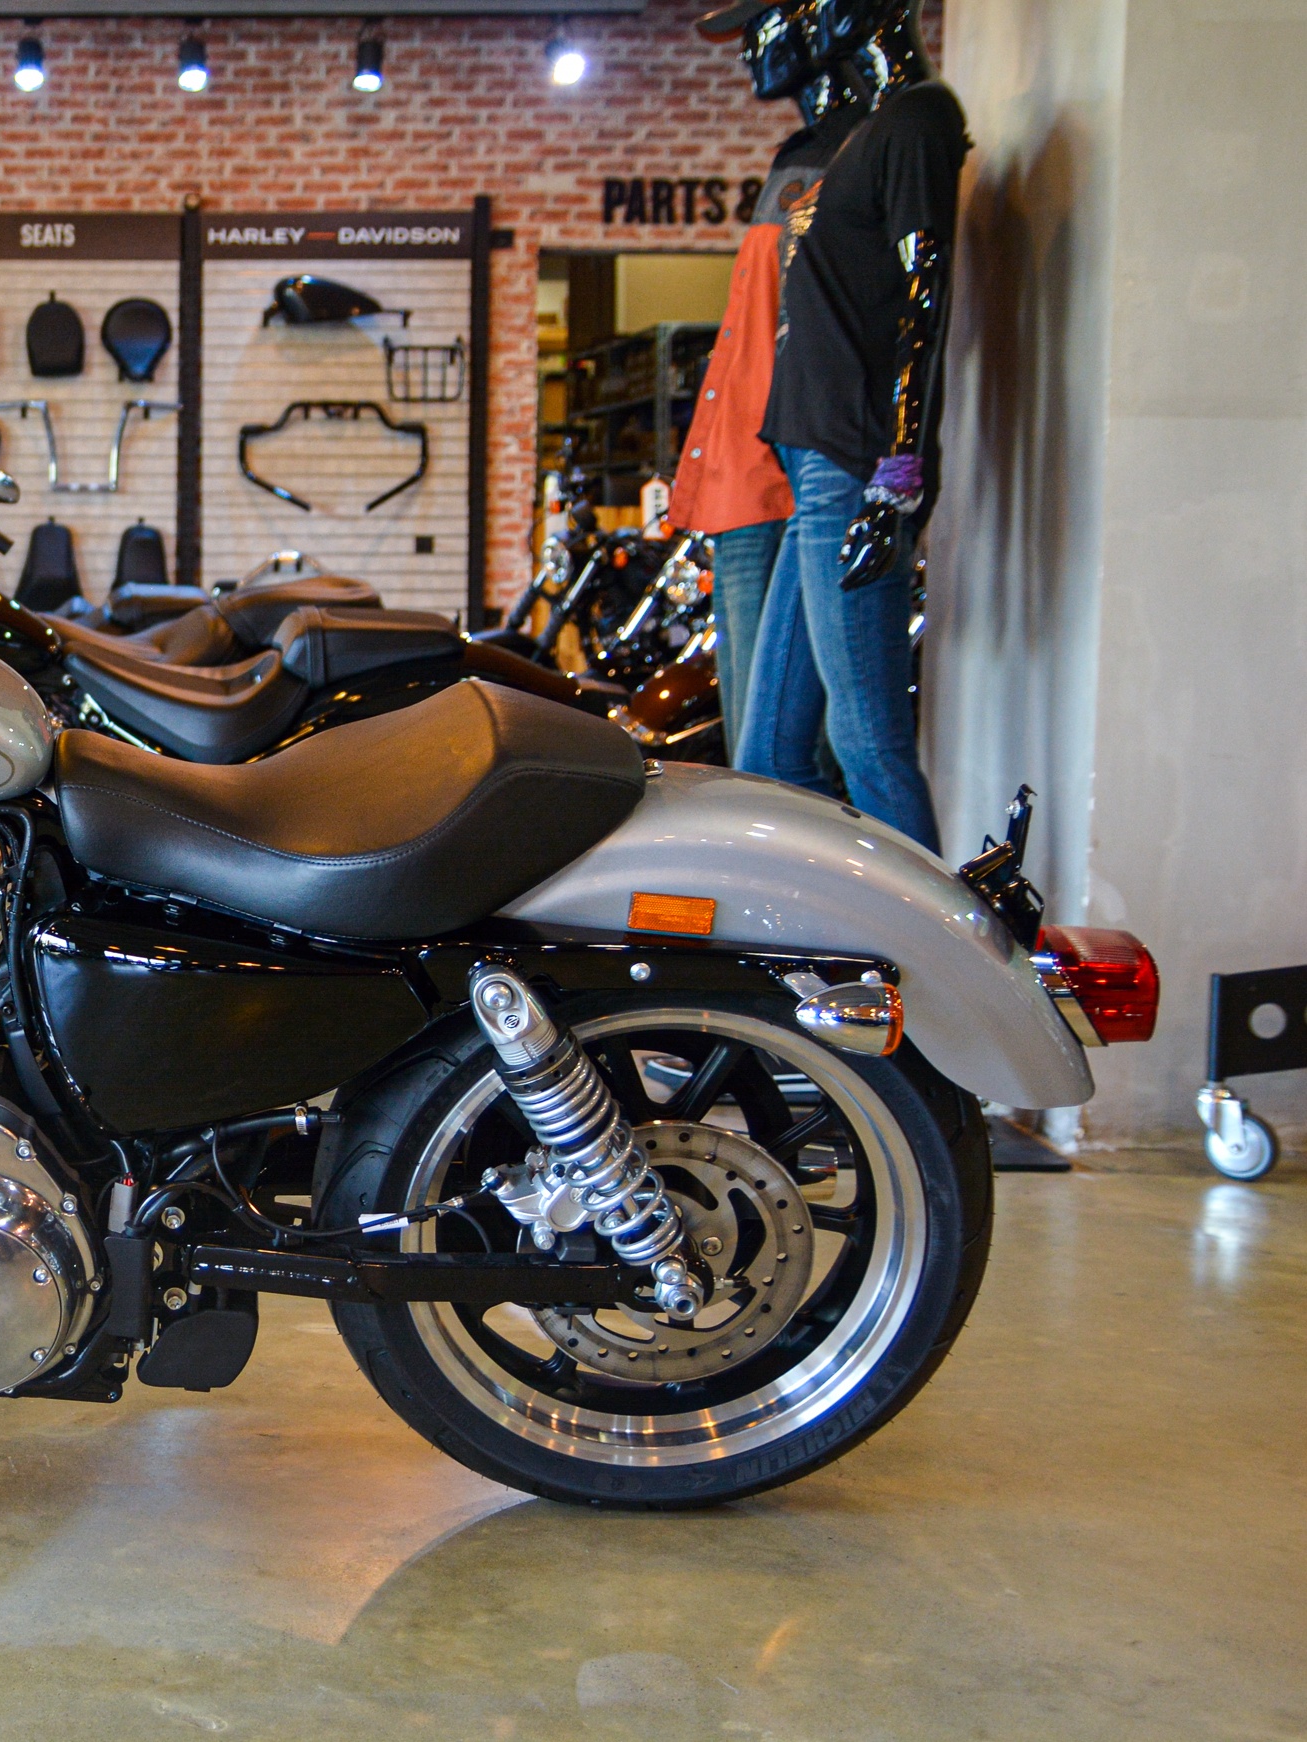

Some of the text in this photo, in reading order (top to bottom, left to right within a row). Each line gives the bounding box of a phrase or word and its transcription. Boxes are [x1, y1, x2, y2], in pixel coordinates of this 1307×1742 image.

[603, 177, 728, 224] PARTS
[20, 223, 76, 247] SEATS
[207, 227, 460, 245] HARLEY DAVIDSON
[735, 1388, 878, 1484] MICHELIN
